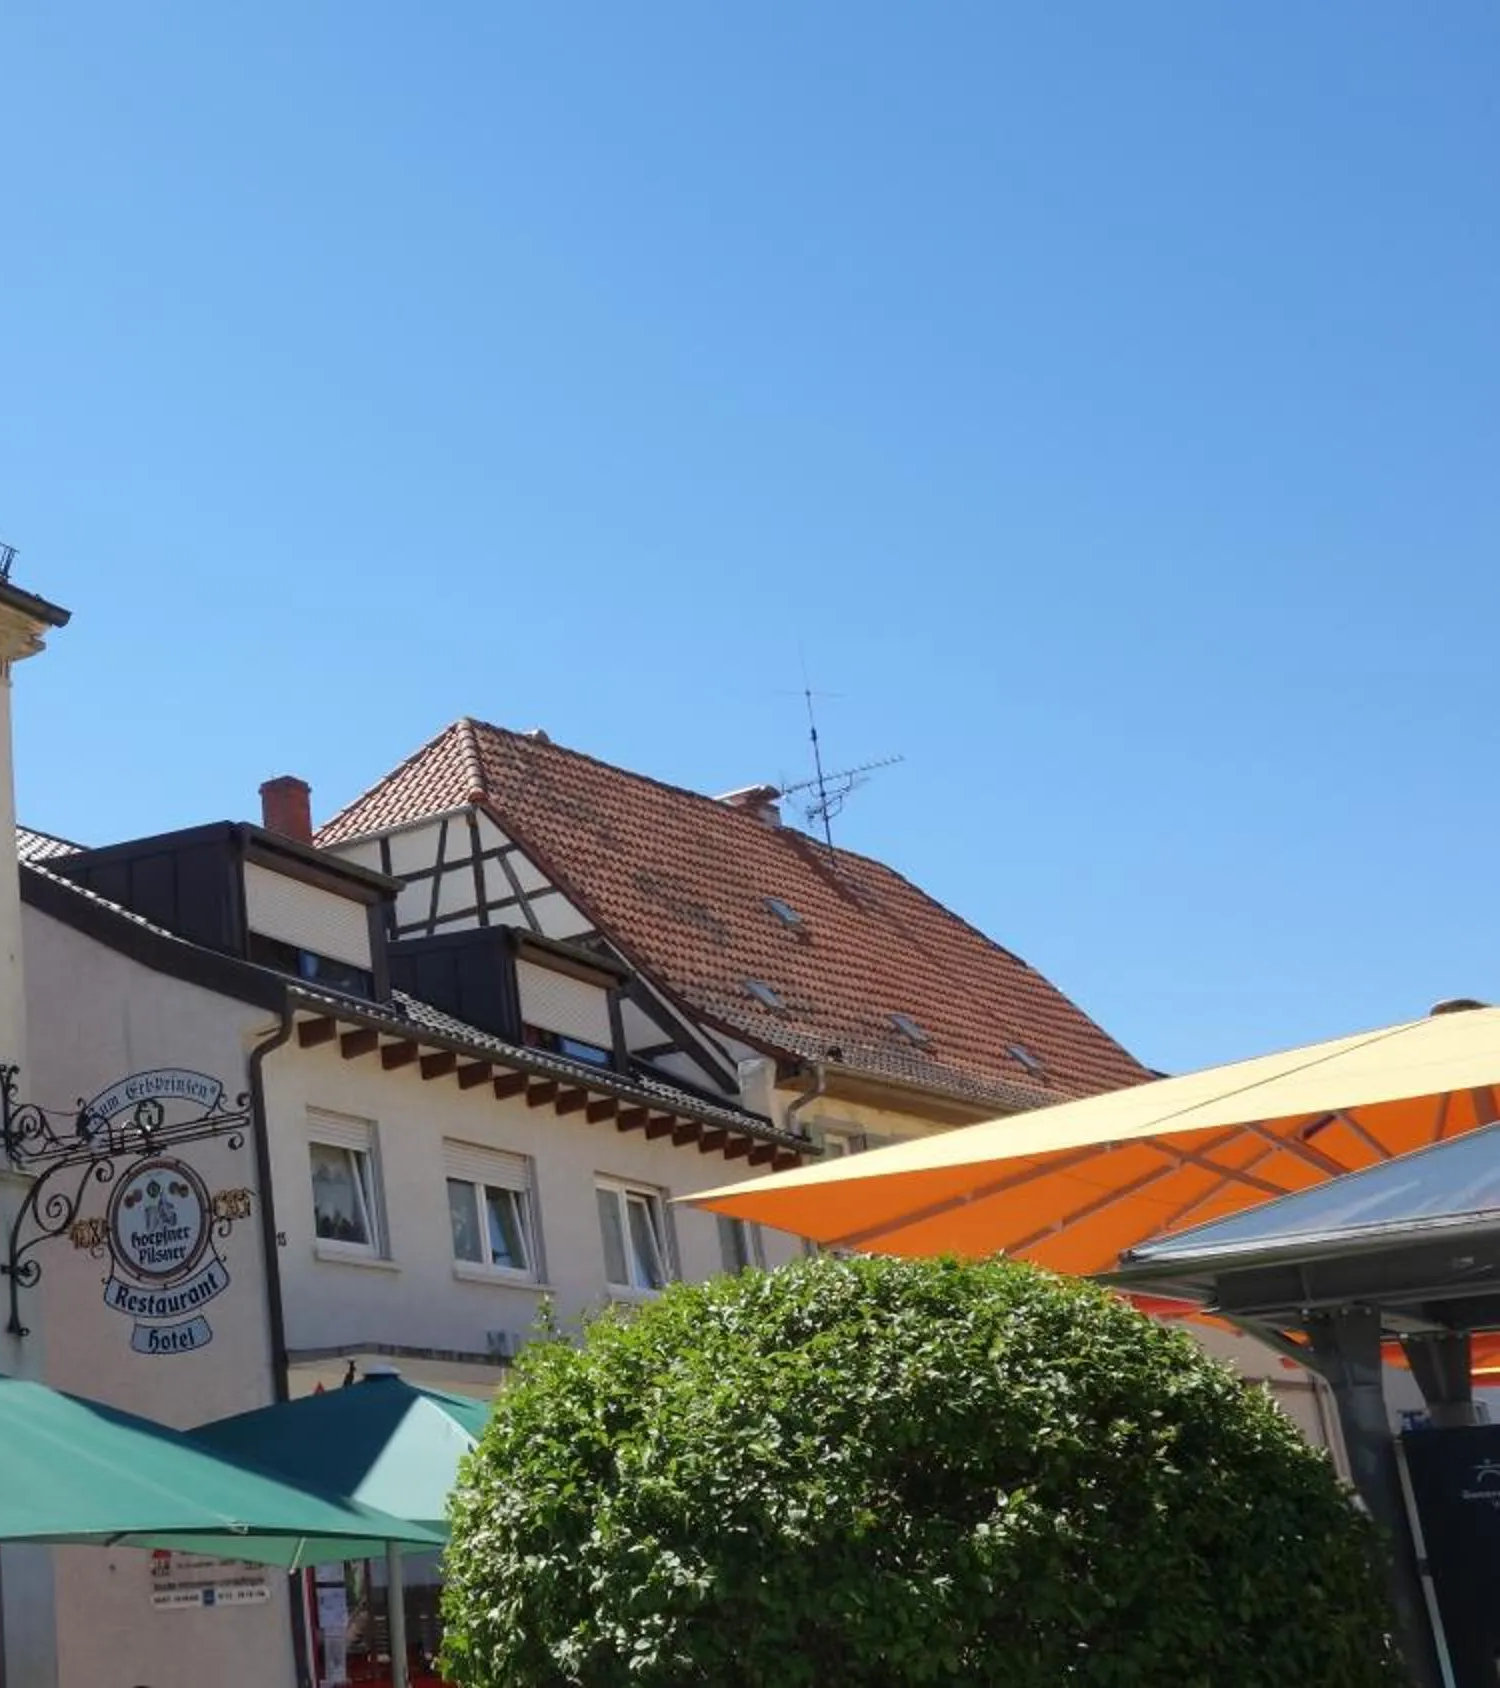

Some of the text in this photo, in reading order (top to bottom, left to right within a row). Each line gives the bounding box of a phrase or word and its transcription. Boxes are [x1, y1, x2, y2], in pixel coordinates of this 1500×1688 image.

[131, 1225, 191, 1249] Hoepfner
[139, 1244, 186, 1265] Pilsner
[114, 1274, 219, 1315] Restaurant
[148, 1327, 195, 1354] Hotel
